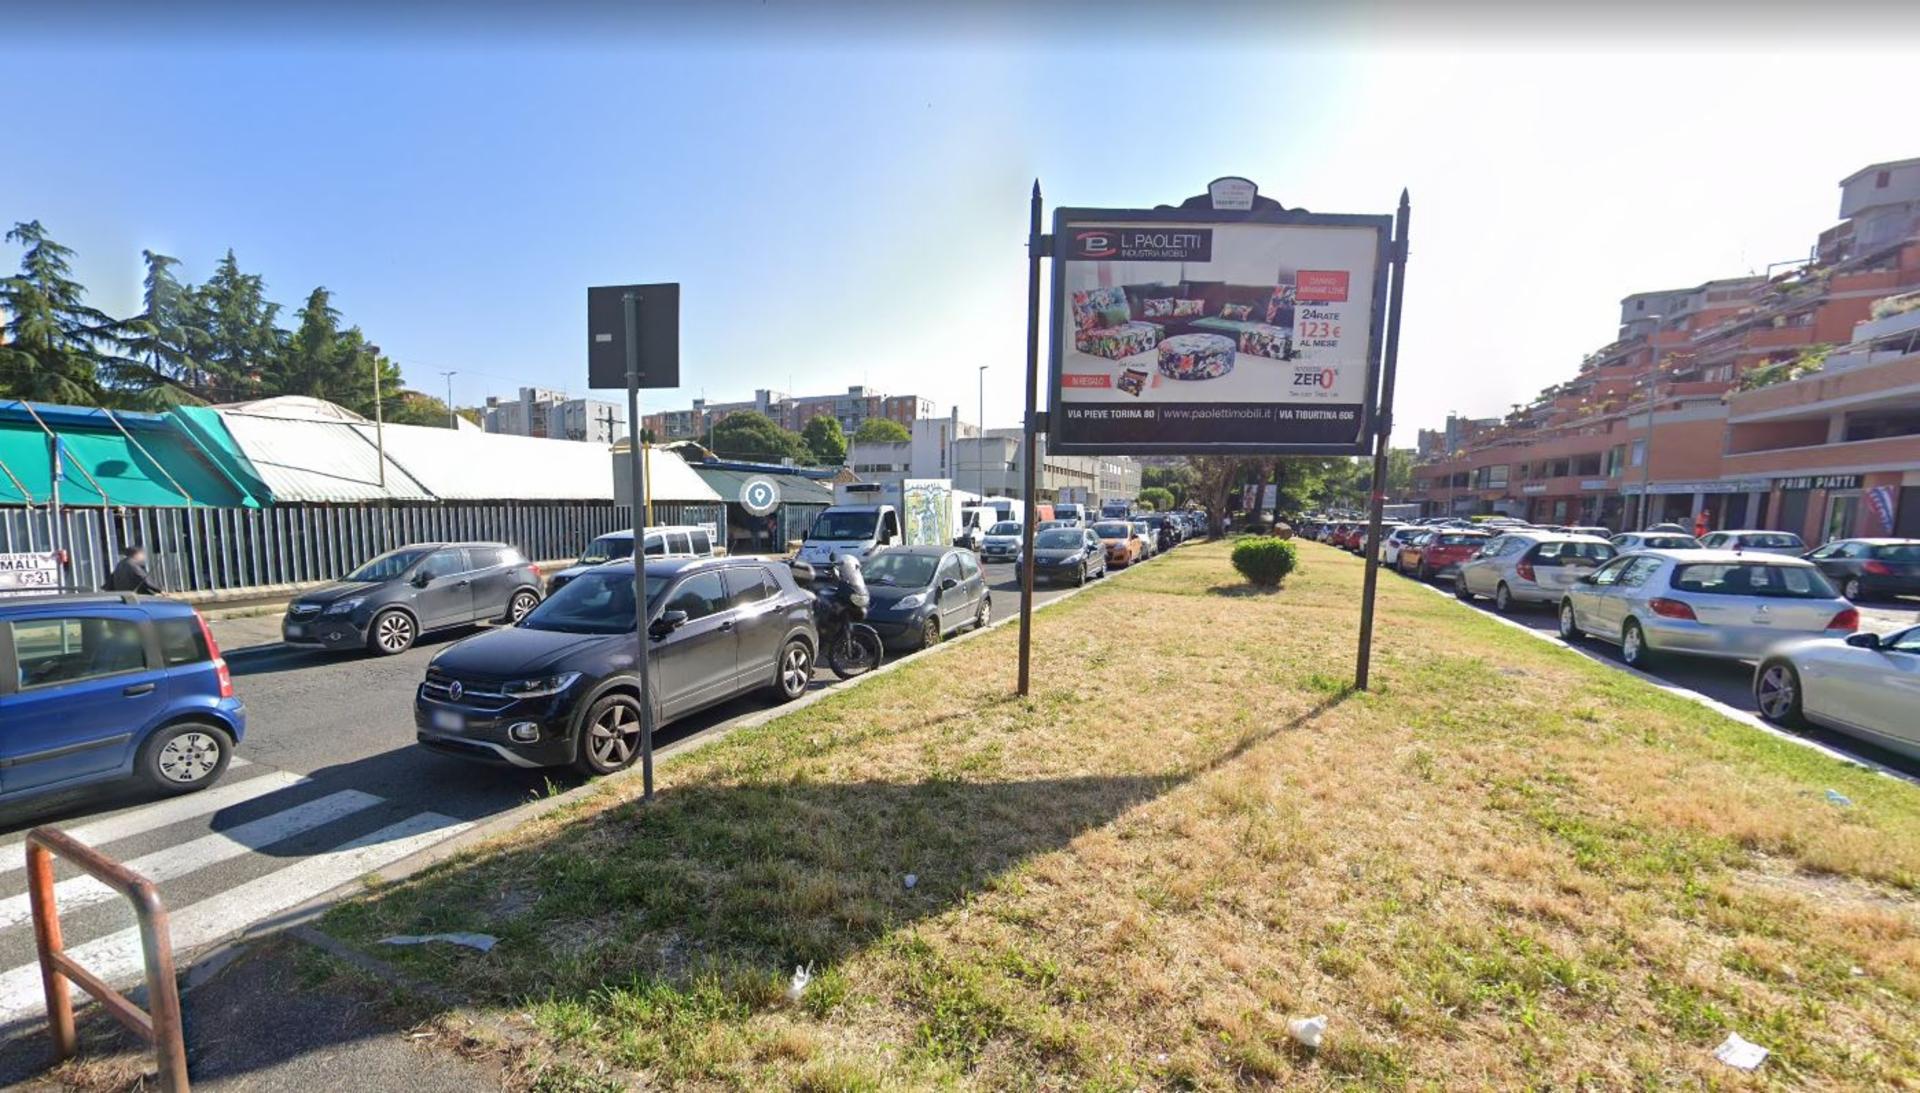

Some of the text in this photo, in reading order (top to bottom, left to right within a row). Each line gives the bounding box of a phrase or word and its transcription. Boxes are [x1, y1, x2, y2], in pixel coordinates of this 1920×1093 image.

[1121, 234, 1201, 249] L. PAOLETTI
[1121, 249, 1188, 258] INDUSTRIA MOBILI
[1298, 321, 1330, 338] 123
[1312, 340, 1338, 348] MESE
[1067, 409, 1082, 419] VIA
[1084, 409, 1109, 419] PIEVE
[1110, 409, 1142, 419] TORINA
[1163, 408, 1271, 421] www.paolettimobili.it
[1279, 409, 1294, 420] VIA
[1295, 410, 1338, 420] TIBURTINA
[1779, 475, 1856, 489] PRIMI PIATTI
